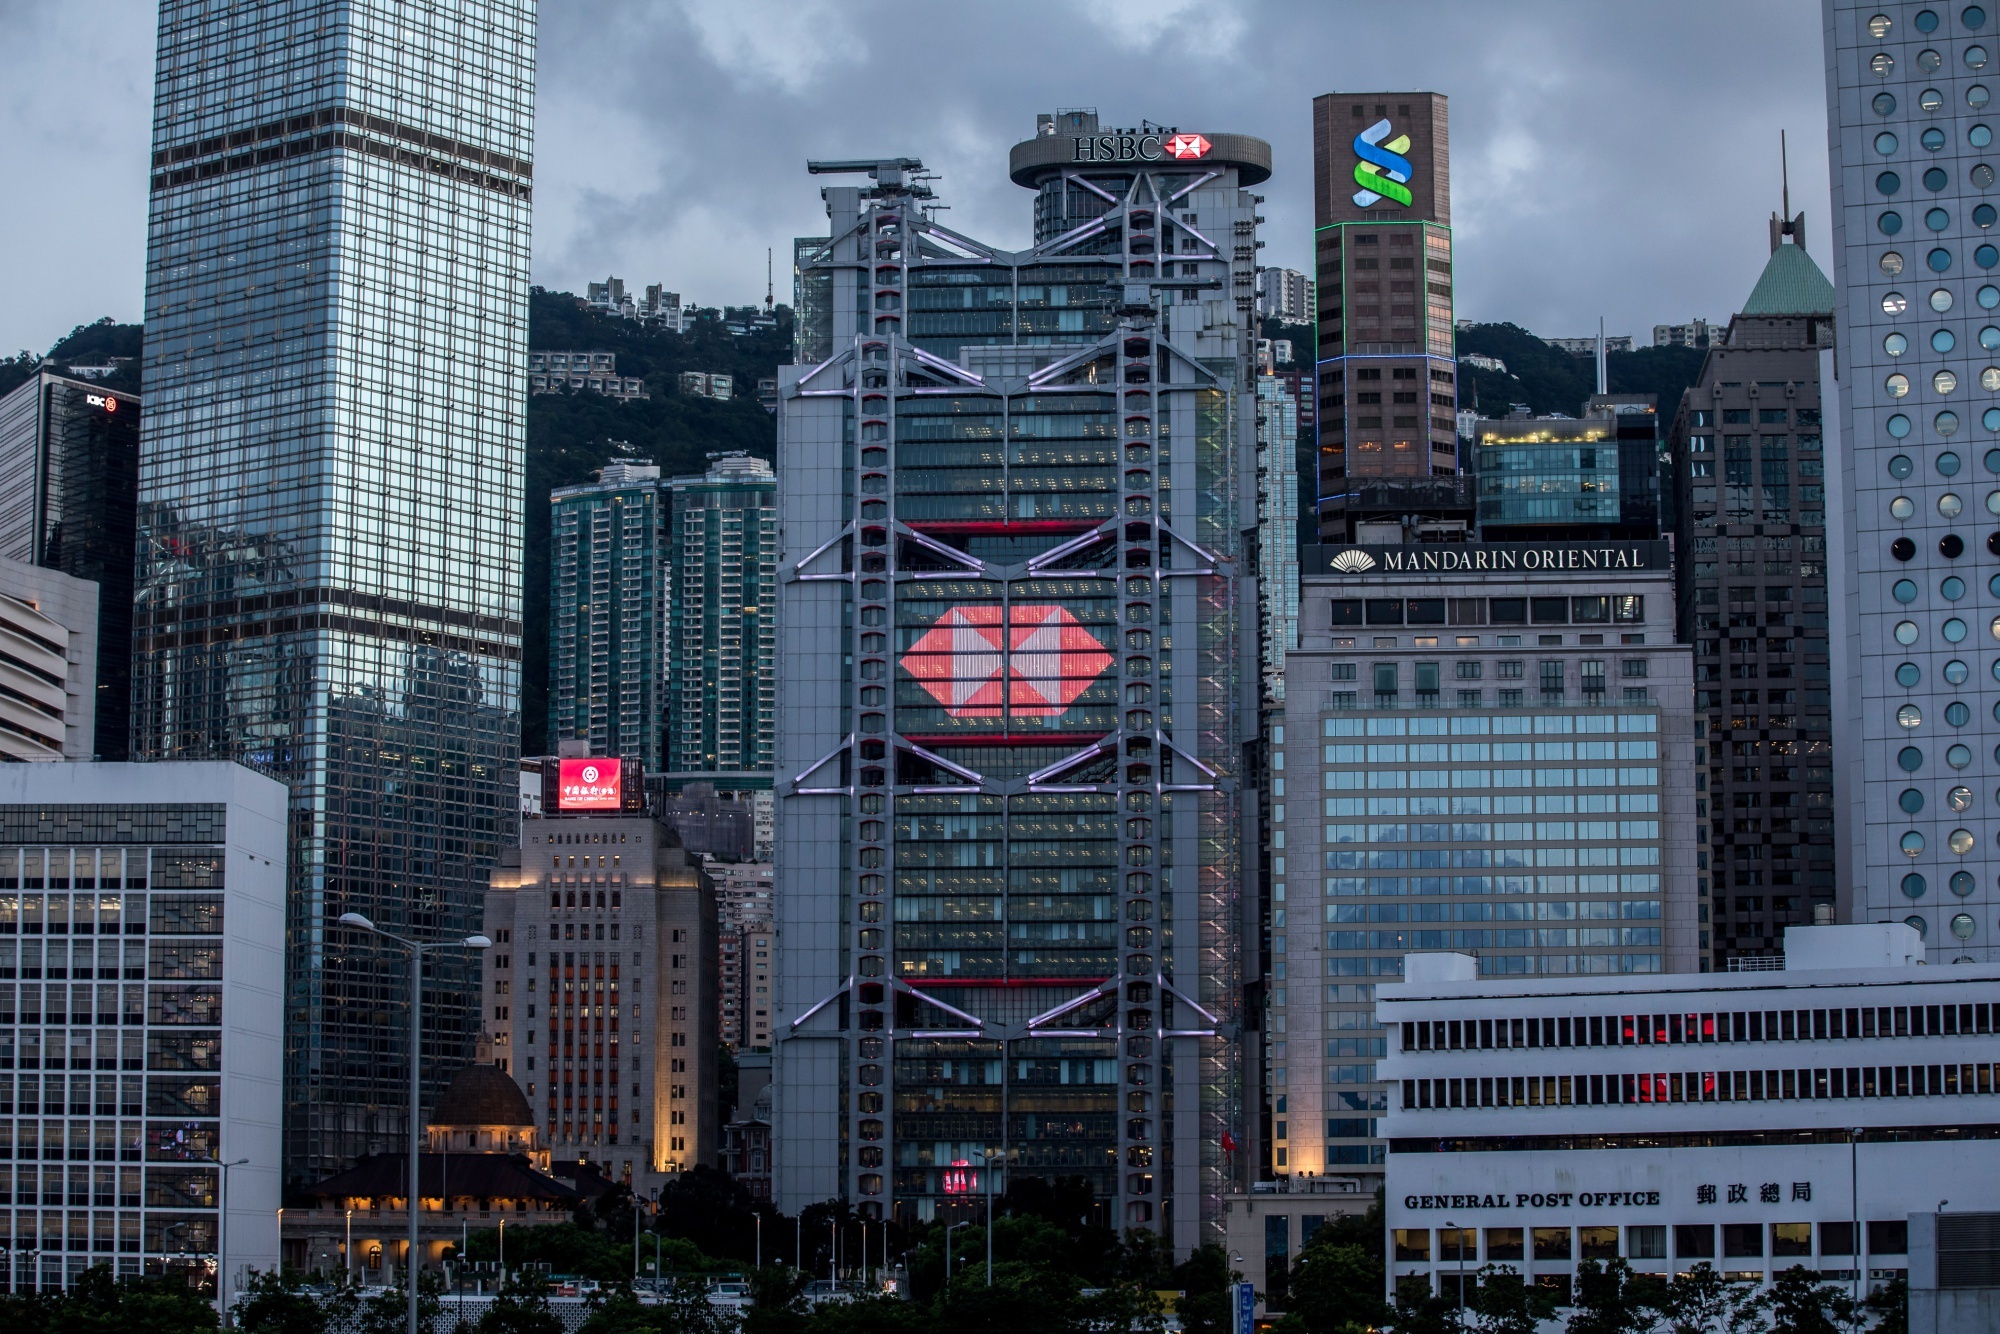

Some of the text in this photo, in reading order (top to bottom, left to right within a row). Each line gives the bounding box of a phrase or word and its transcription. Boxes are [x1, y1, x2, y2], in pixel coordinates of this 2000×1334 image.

[1072, 135, 1161, 161] HSBC
[1384, 548, 1644, 571] MANDARIN ORIENTAL
[1404, 1191, 1660, 1209] GENERAL POST OFFICE
[1696, 1181, 1812, 1204] 郵政總局
